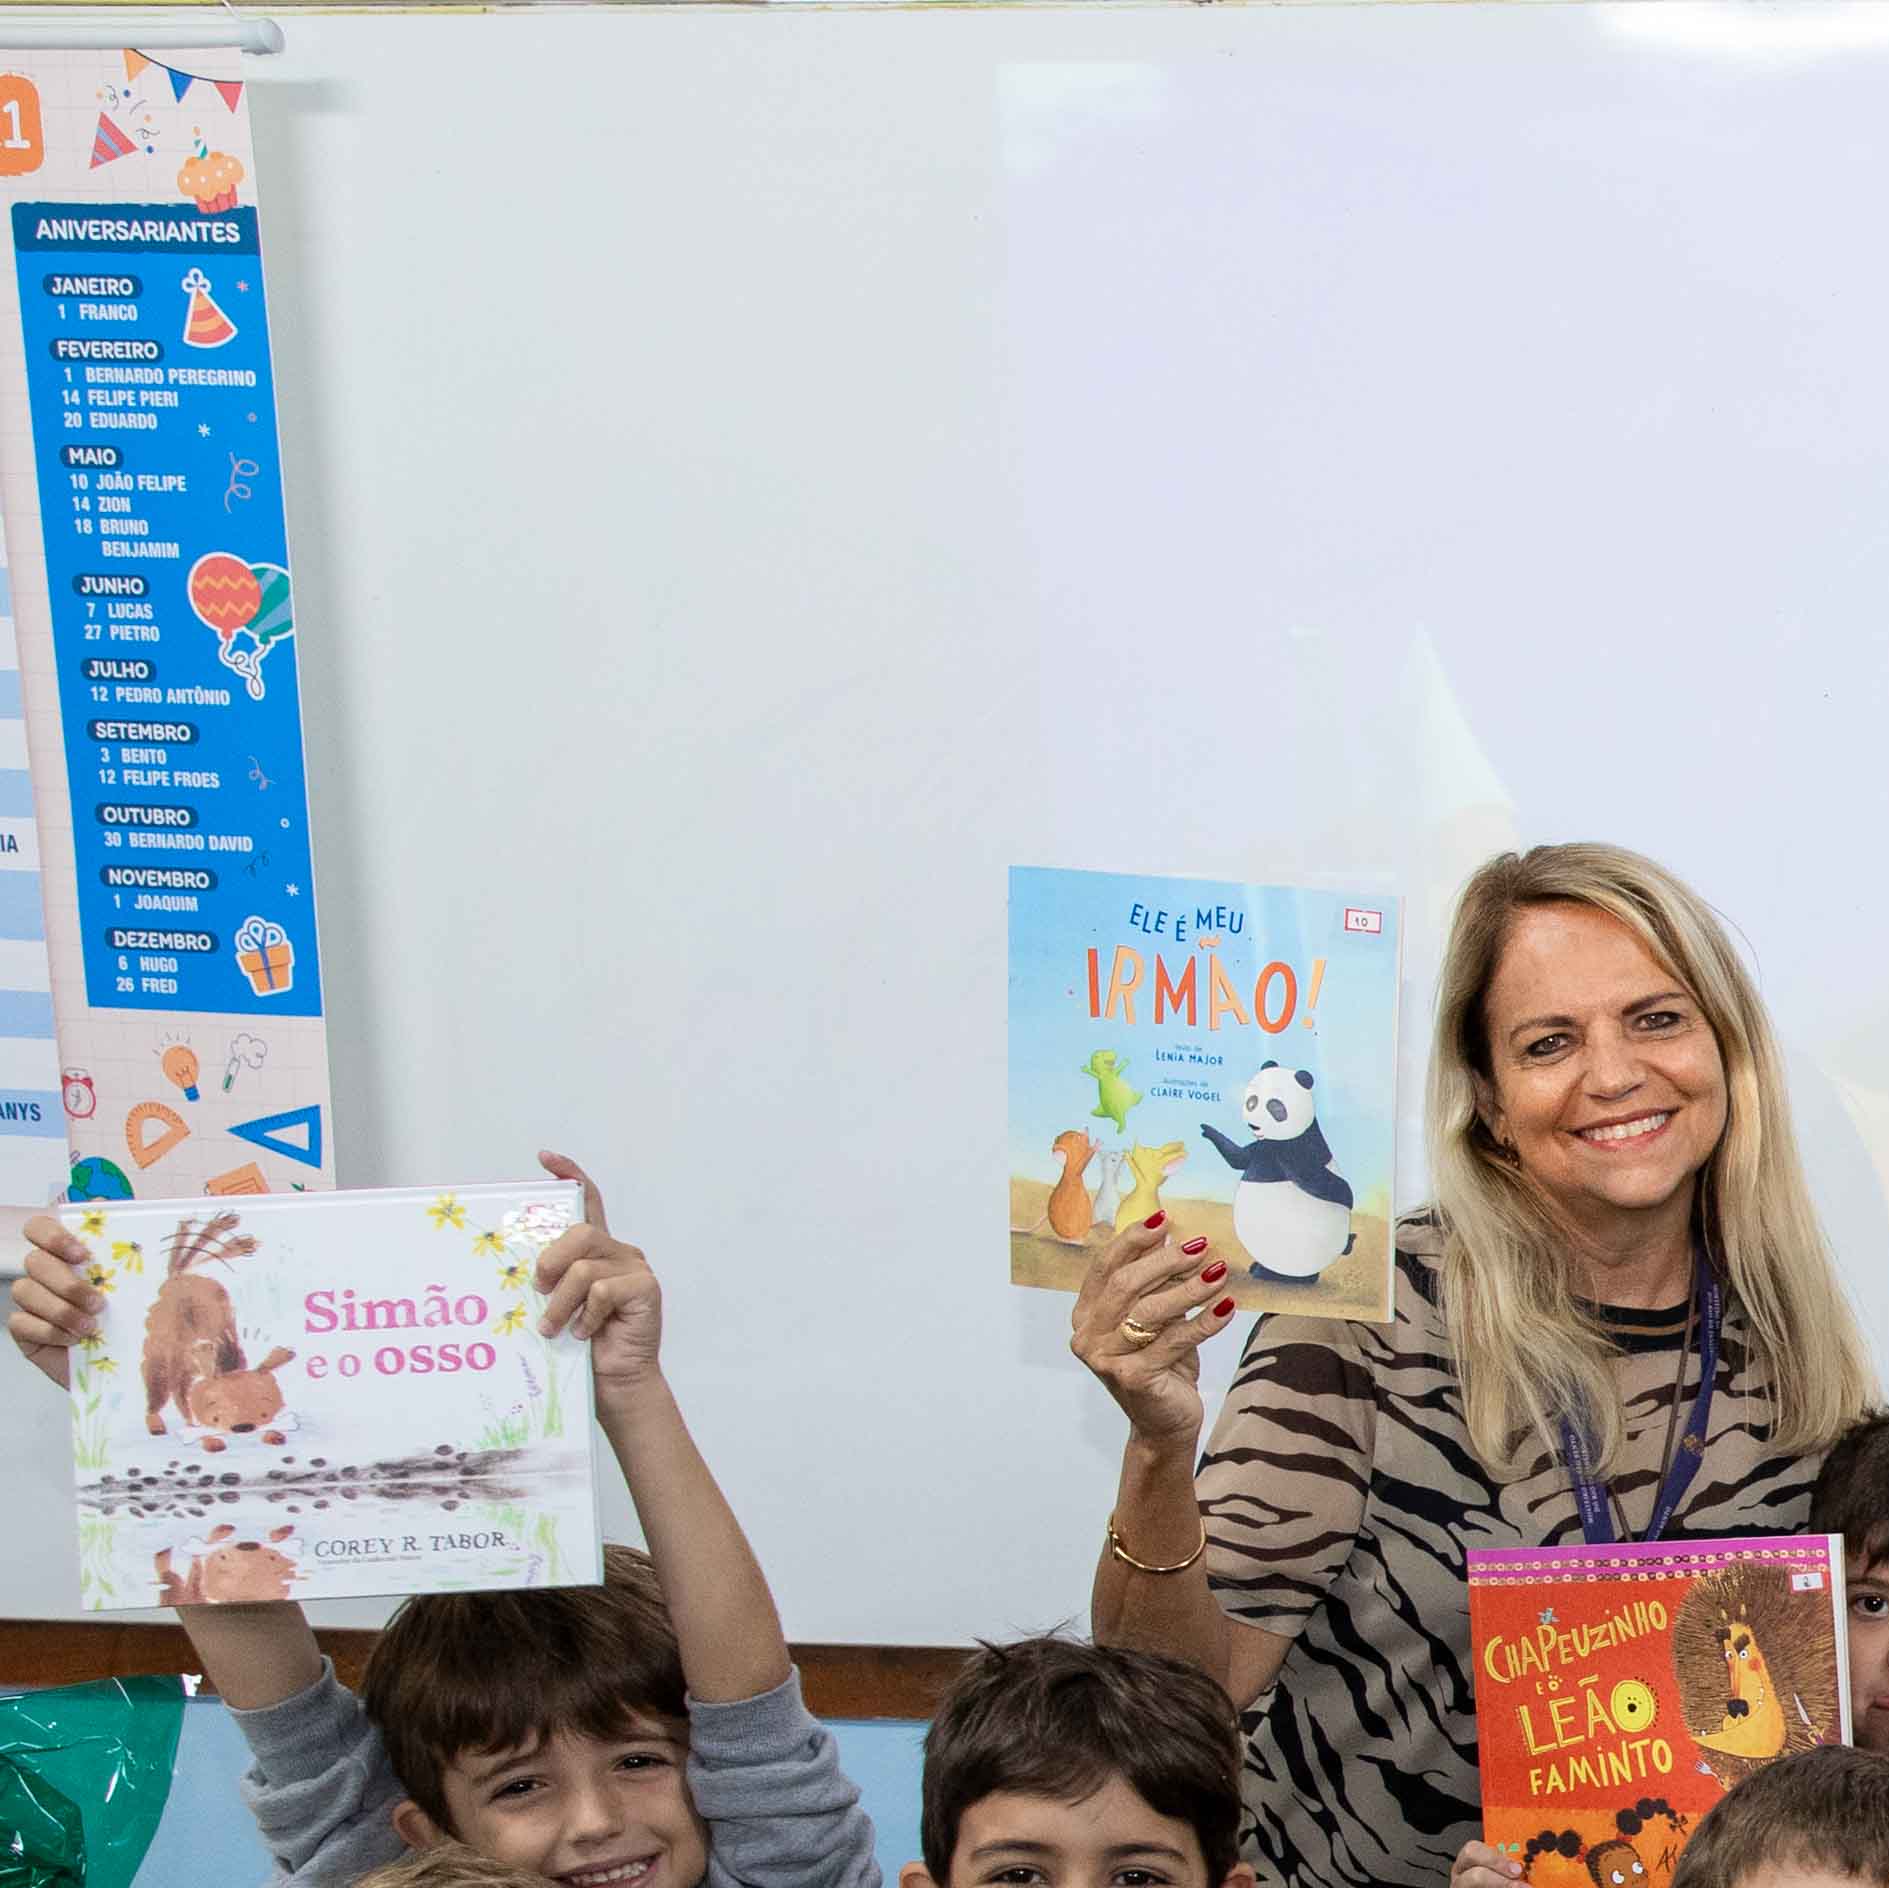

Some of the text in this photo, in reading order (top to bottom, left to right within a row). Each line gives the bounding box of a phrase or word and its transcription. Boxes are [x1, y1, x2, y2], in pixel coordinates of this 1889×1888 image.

[36, 219, 240, 244] ANIVERSARIANTES
[51, 277, 133, 296] JANEIRO
[80, 304, 138, 321] FRANCO
[57, 339, 157, 360] FEVEREIRO
[85, 366, 256, 387] BERNARDO PEREGRINO
[88, 389, 179, 408] FELIPE PIERI
[90, 412, 157, 430] EDUARDO
[69, 447, 117, 466] MAIO
[96, 470, 187, 493] JOÃO FELIPE
[98, 496, 131, 513] ZION
[100, 518, 149, 536] BRUNO
[102, 540, 180, 559] BENJAMIM
[81, 576, 144, 595] JUNHO
[107, 602, 154, 620] LUCAS
[109, 624, 161, 643] PIETRO
[89, 662, 148, 680] JULHO
[115, 684, 231, 706] PEDRO ANTÔNIO
[95, 722, 191, 743] SETEMBRO
[121, 748, 167, 765] BENTO
[123, 770, 170, 788] FELIPE
[103, 806, 191, 827] OUTUBRO
[128, 832, 254, 853] BERNARDO DAVID
[108, 868, 210, 889] NOVEMBRO
[134, 895, 199, 914] JOAQUIM
[1129, 903, 1244, 942] ELE É MEU
[114, 930, 212, 952] DEZEMBRO
[140, 956, 178, 974] HUGO
[141, 977, 178, 995] FRED
[1087, 934, 1326, 1034] IRMÃO!
[1189, 1053, 1223, 1067] MAJOR
[1188, 1089, 1221, 1102] VOGEL
[304, 1285, 488, 1335] Simão
[306, 1340, 497, 1378] e o osso
[314, 1531, 505, 1558] COREY TABOR
[1484, 1600, 1667, 1684] CHAPEUZINHO
[1519, 1674, 1658, 1756] LEÃO
[1530, 1738, 1673, 1796] FAMINTO
